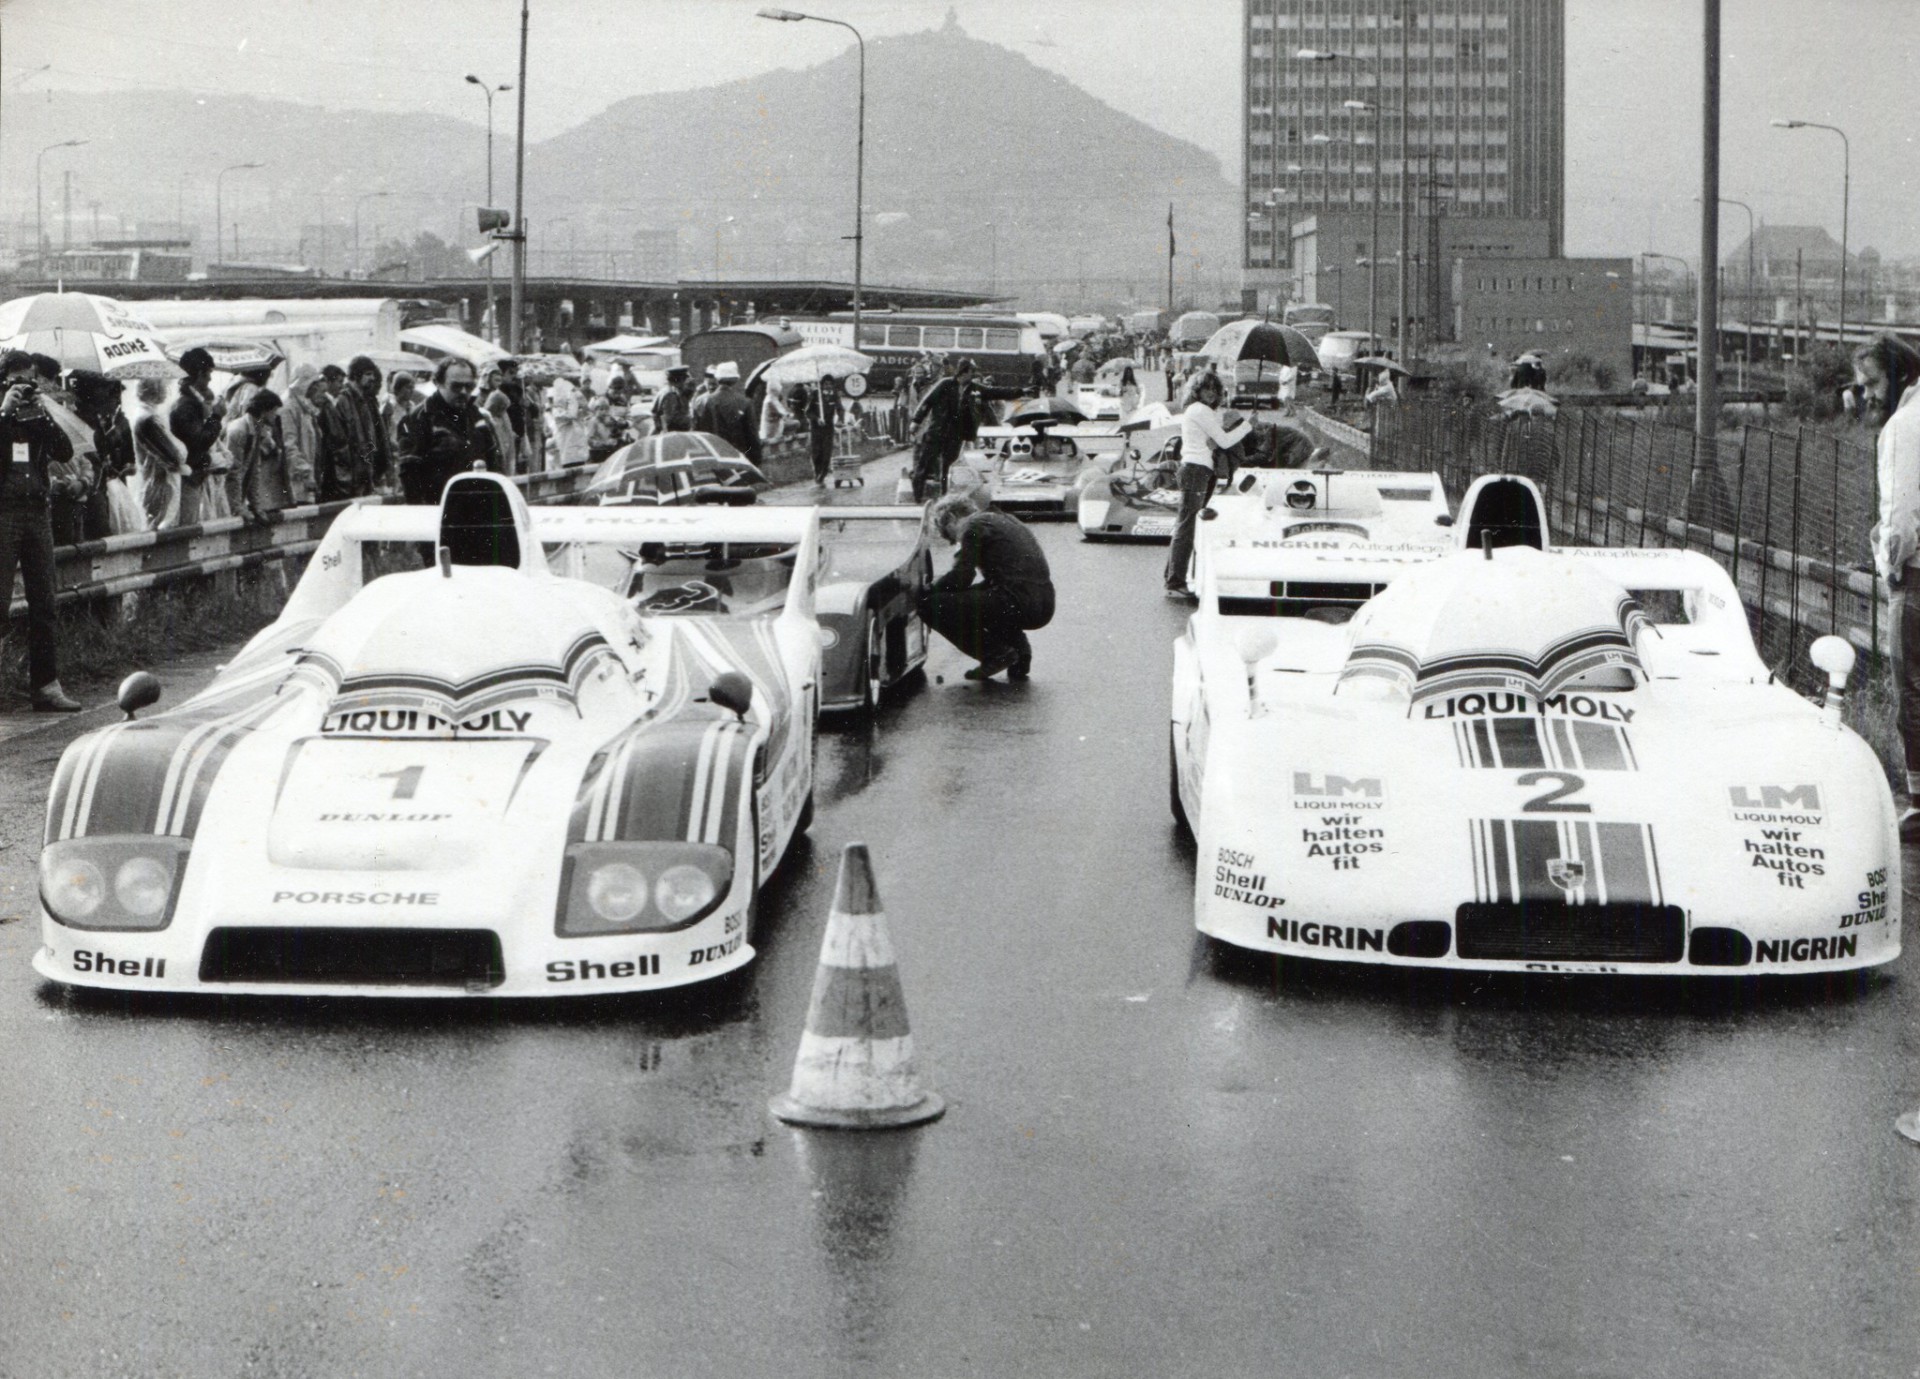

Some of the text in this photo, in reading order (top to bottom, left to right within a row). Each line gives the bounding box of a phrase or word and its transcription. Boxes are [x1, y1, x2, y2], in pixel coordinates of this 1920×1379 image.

[1252, 540, 1340, 550] NIGRIN
[1424, 691, 1636, 722] LIQUI MOLY
[320, 710, 418, 732] LIQUI
[378, 765, 425, 799] 1
[1293, 772, 1382, 797] LM
[1517, 771, 1591, 813] 2
[1294, 801, 1337, 809] LIQUI
[1728, 785, 1820, 810] LM
[319, 813, 452, 821] DUNLOP
[1321, 813, 1362, 826] wir
[1734, 812, 1822, 825] LIQUI MOLY
[1302, 828, 1384, 842] halten
[1761, 828, 1802, 842] wir
[1218, 848, 1255, 868] BOSCH
[1307, 842, 1384, 857] Autos
[1744, 839, 1825, 860] halten
[1332, 855, 1361, 870] fit
[1752, 854, 1825, 876] Autos
[1215, 866, 1266, 891] Shell
[1777, 872, 1805, 889] fit
[272, 890, 440, 906] PORSCHE
[1214, 884, 1286, 909] DUNLOP
[1267, 916, 1384, 952] NIGRIN
[1756, 934, 1858, 963] NIGRIN
[73, 949, 166, 978] Shell
[546, 954, 660, 982] Shell
